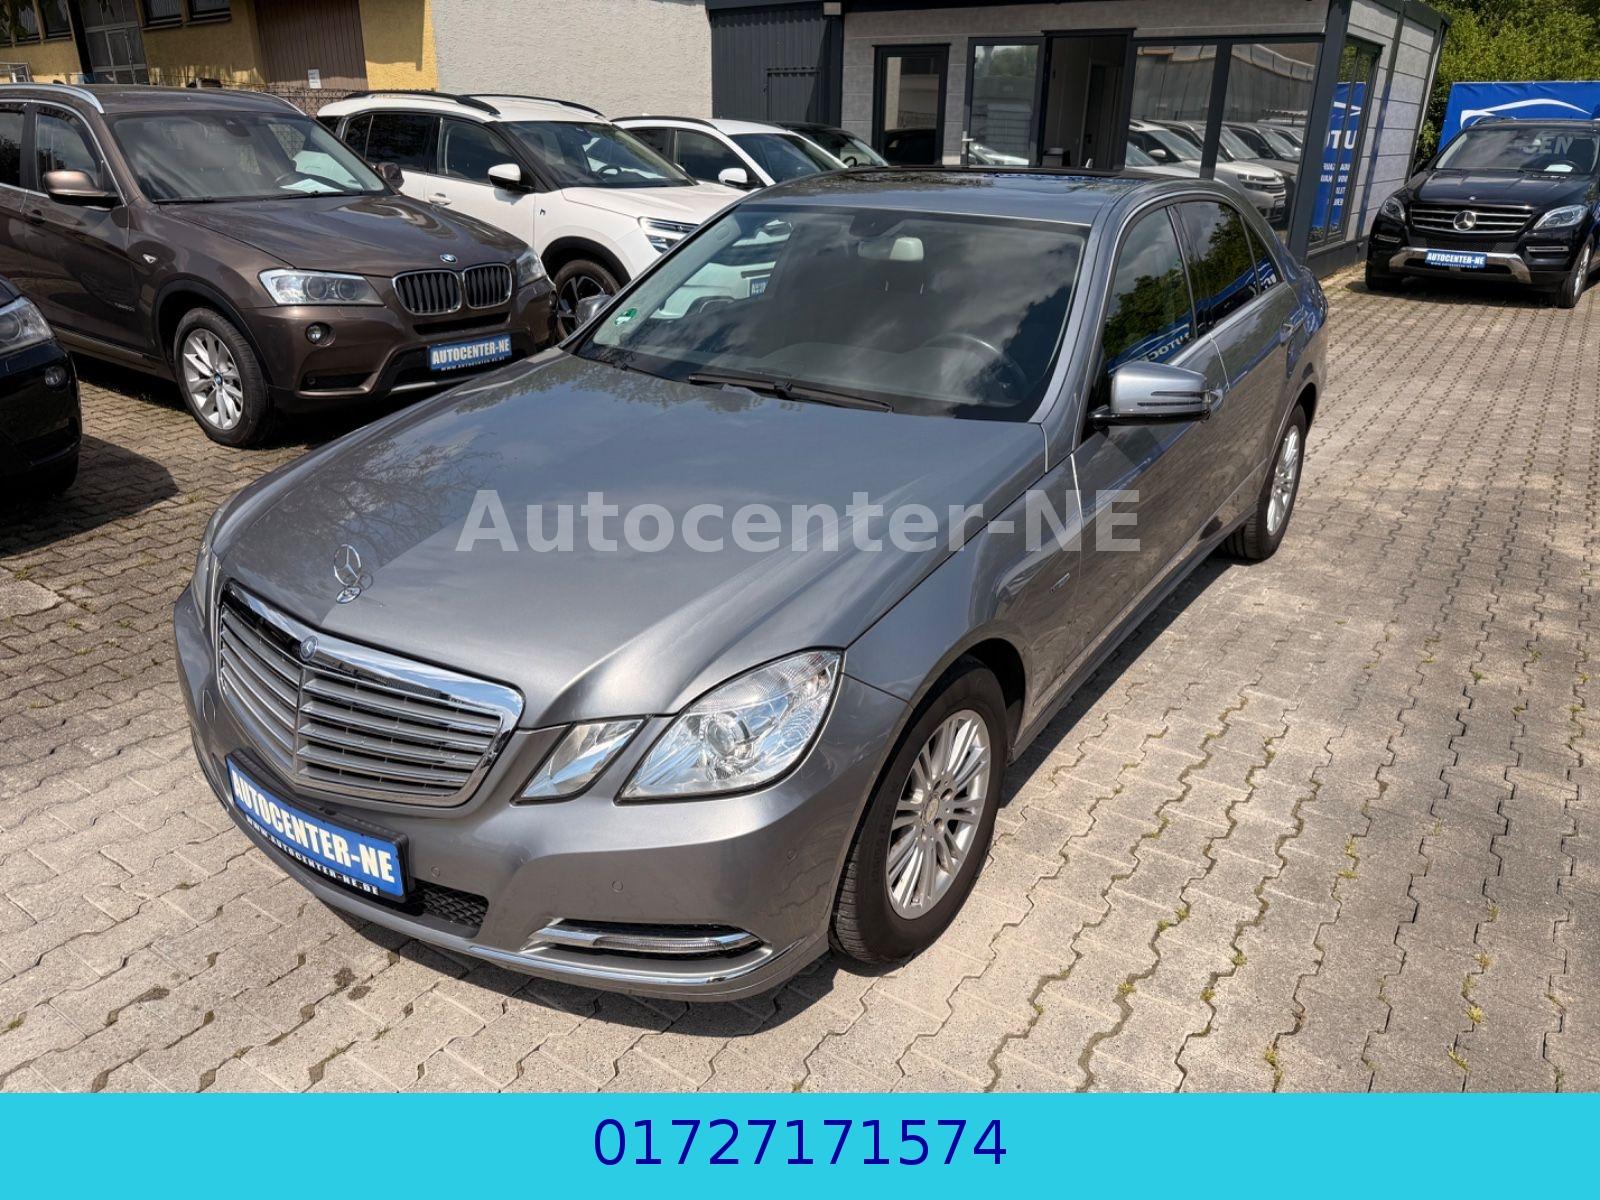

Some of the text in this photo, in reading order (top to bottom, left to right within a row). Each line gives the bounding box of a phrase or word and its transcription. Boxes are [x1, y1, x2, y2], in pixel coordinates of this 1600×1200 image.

[1426, 252, 1485, 265] AUTOCENTER-NE
[432, 339, 510, 365] AUTOCENTER-NE
[231, 768, 395, 884] AUTOCENTER-NE
